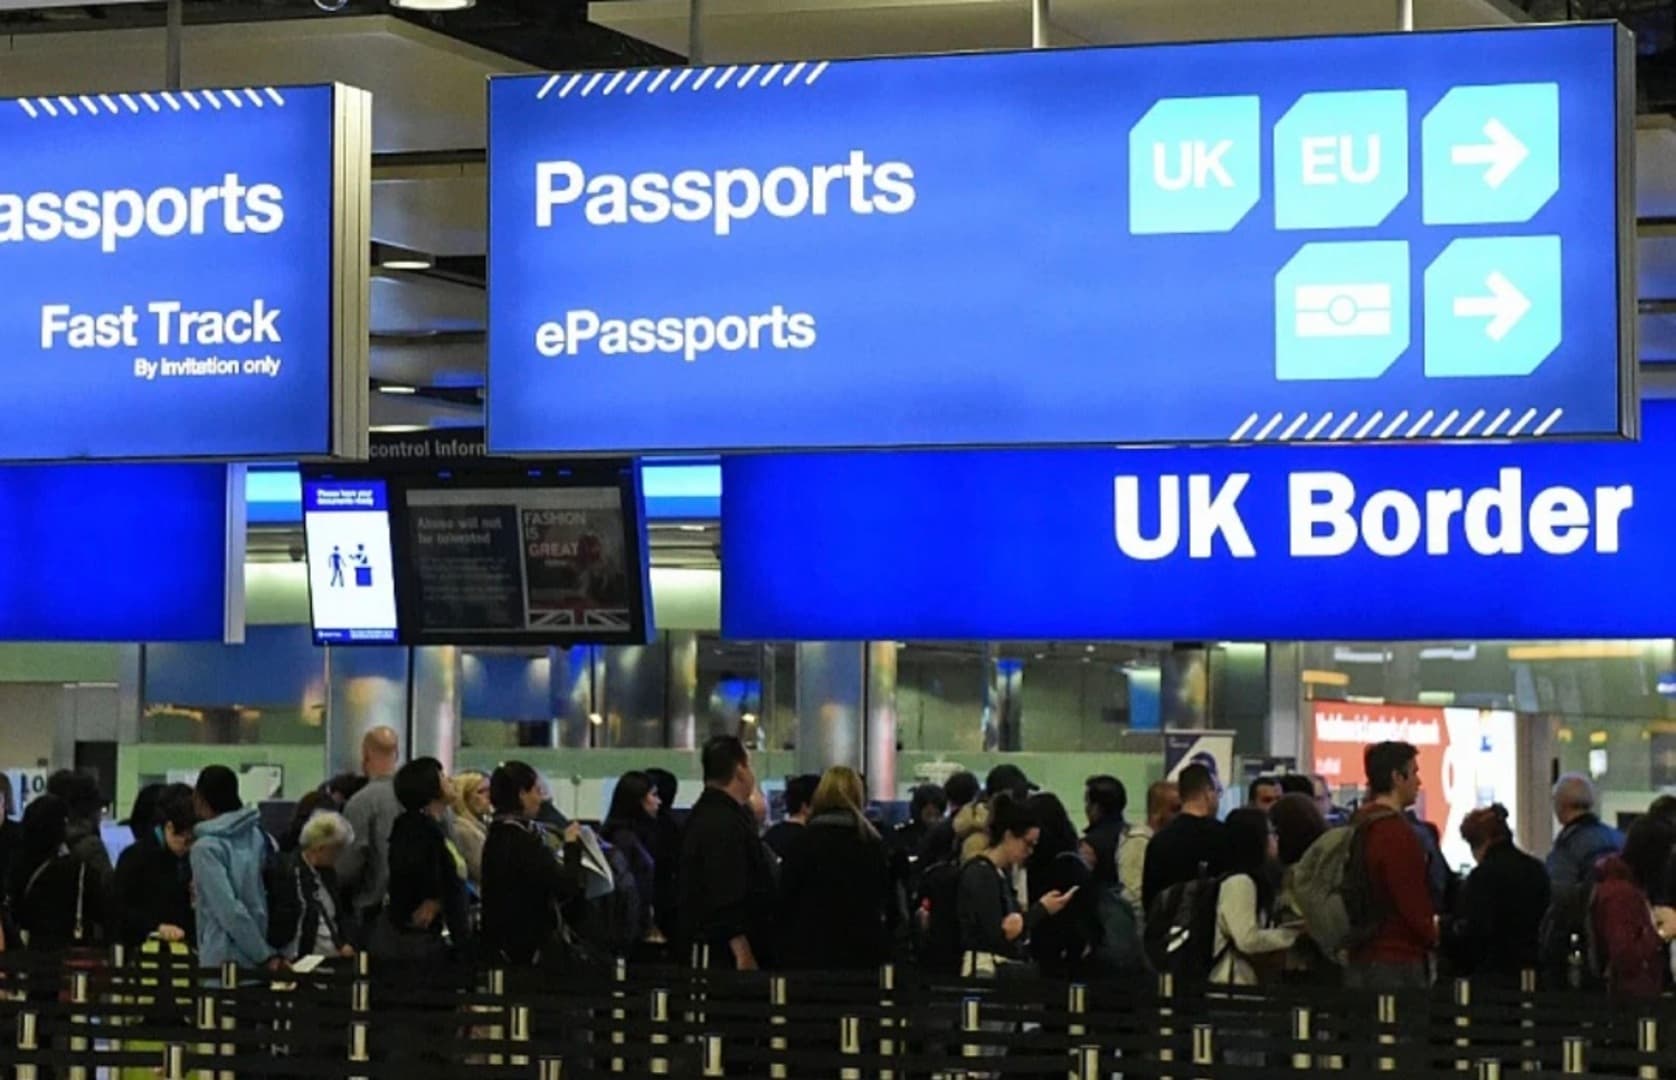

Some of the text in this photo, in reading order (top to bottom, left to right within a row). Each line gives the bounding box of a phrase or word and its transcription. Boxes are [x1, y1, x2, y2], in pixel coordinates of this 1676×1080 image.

[1152, 139, 1235, 190] UK
[1301, 133, 1381, 184] EU
[0, 173, 284, 253] assports
[535, 150, 916, 235] Passports
[41, 299, 281, 349] Fast Track
[535, 305, 817, 361] ePassports
[134, 358, 158, 380] By
[243, 355, 281, 377] only
[370, 439, 430, 457] control
[1114, 467, 1633, 560] UK Border
[528, 542, 578, 558] GREAT
